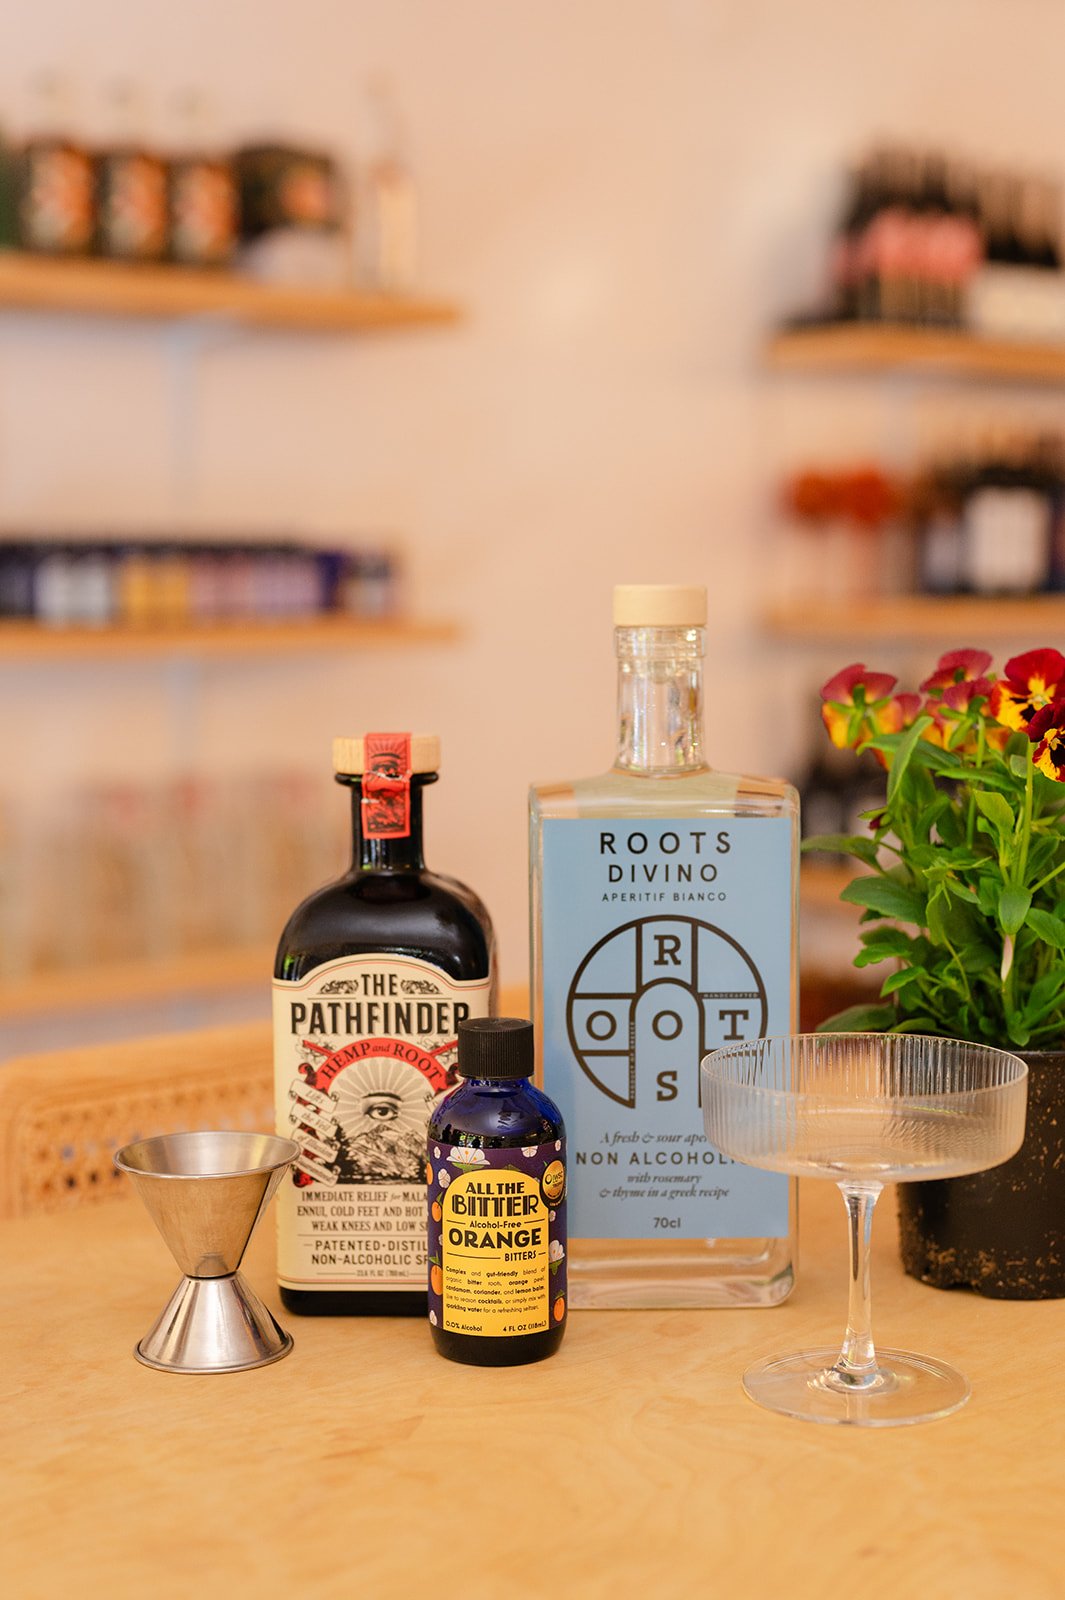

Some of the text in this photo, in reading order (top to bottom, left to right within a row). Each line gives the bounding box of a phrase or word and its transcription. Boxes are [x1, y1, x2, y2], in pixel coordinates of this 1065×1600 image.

[600, 831, 731, 854] ROOTS
[608, 864, 718, 883] DIVINO
[602, 892, 727, 902] APERITIF BIANCO
[653, 935, 682, 966] R
[361, 974, 398, 996] THE
[321, 1042, 442, 1080] HEMP and ROOT
[656, 1070, 679, 1102] S
[600, 1132, 609, 1144] A
[610, 1131, 640, 1147] fresh
[642, 1133, 654, 1144] &
[656, 1135, 683, 1144] sour
[576, 1152, 748, 1165] NON ALCOHOL
[627, 1172, 702, 1185] with rosemary
[466, 1182, 524, 1195] ALL THE
[599, 1189, 612, 1198] &
[613, 1187, 645, 1200] thyme
[648, 1187, 659, 1197] in
[668, 1186, 697, 1200] greek
[699, 1188, 730, 1200] recipe
[302, 1191, 356, 1202] IMMEDIATE
[357, 1191, 388, 1202] RELIEF
[331, 1206, 356, 1217] COLD
[358, 1206, 380, 1216] FEET
[383, 1206, 402, 1216] AND
[405, 1206, 423, 1216] HOT
[451, 1194, 539, 1217] BITTER
[312, 1221, 338, 1232] WEAK
[342, 1221, 371, 1232] KNEES
[373, 1221, 392, 1232] AND
[396, 1221, 417, 1232] LOW
[469, 1221, 522, 1229] Alcohol-Free
[653, 1217, 681, 1229] 70cl
[448, 1228, 542, 1249] ORANGE
[312, 1254, 411, 1265] NON-ALCOHOLIC
[504, 1250, 537, 1262] BITTERS
[446, 1266, 467, 1275] Complex
[523, 1267, 538, 1276] blend
[509, 1279, 528, 1287] orange
[515, 1286, 532, 1294] lemon
[512, 1297, 527, 1305] simply
[446, 1303, 467, 1313] sparkling
[498, 1306, 522, 1315] refreshing
[445, 1320, 460, 1330] 0.0%
[461, 1323, 483, 1332] Alcohol
[517, 1324, 527, 1332] OZ
[527, 1320, 547, 1331] (118mL)
